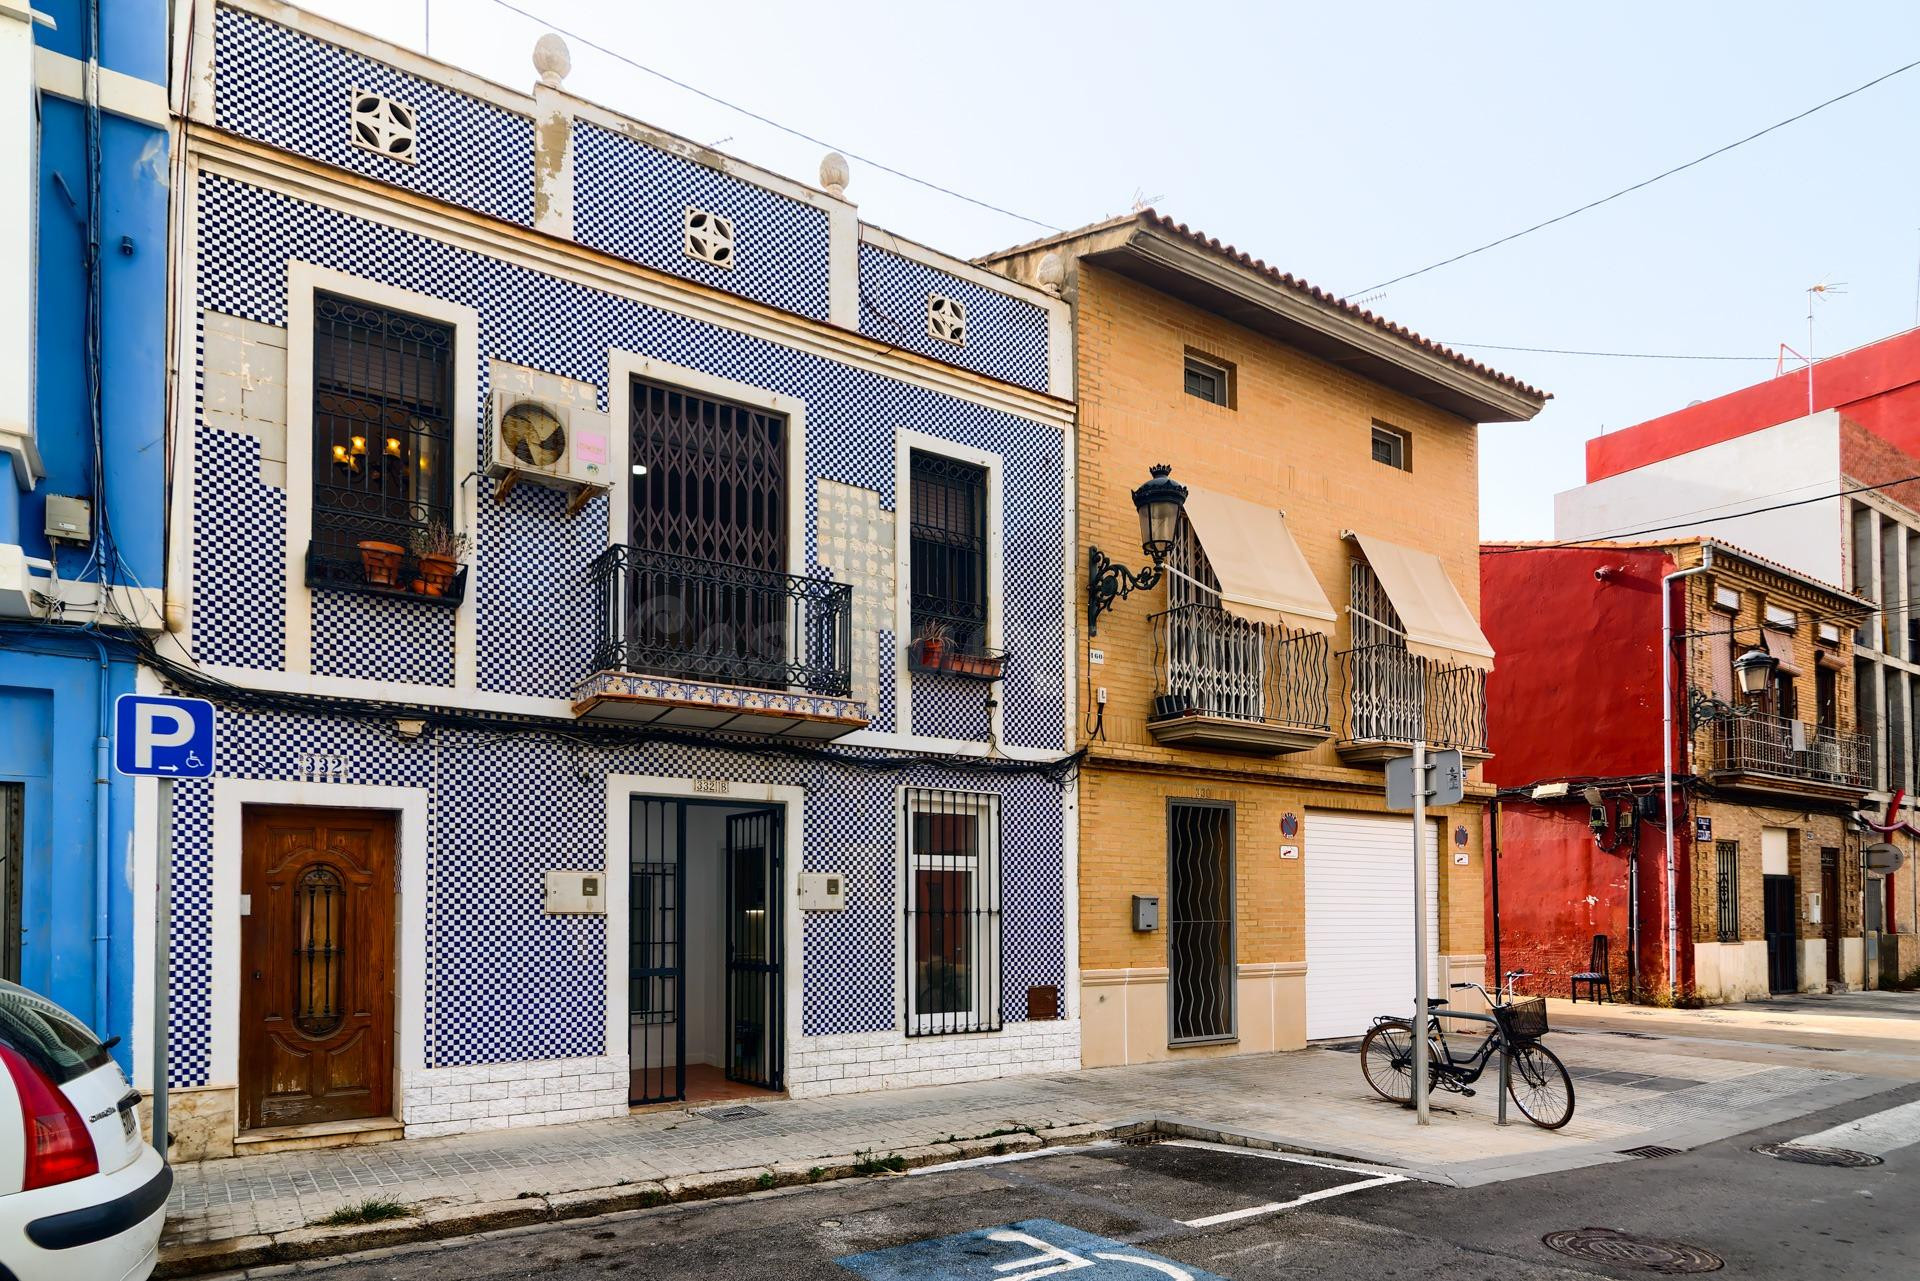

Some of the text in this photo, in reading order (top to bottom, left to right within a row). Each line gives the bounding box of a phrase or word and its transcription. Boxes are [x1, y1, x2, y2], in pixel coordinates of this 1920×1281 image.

[134, 702, 196, 769] P
[305, 756, 342, 774] 332
[696, 781, 715, 791] 332
